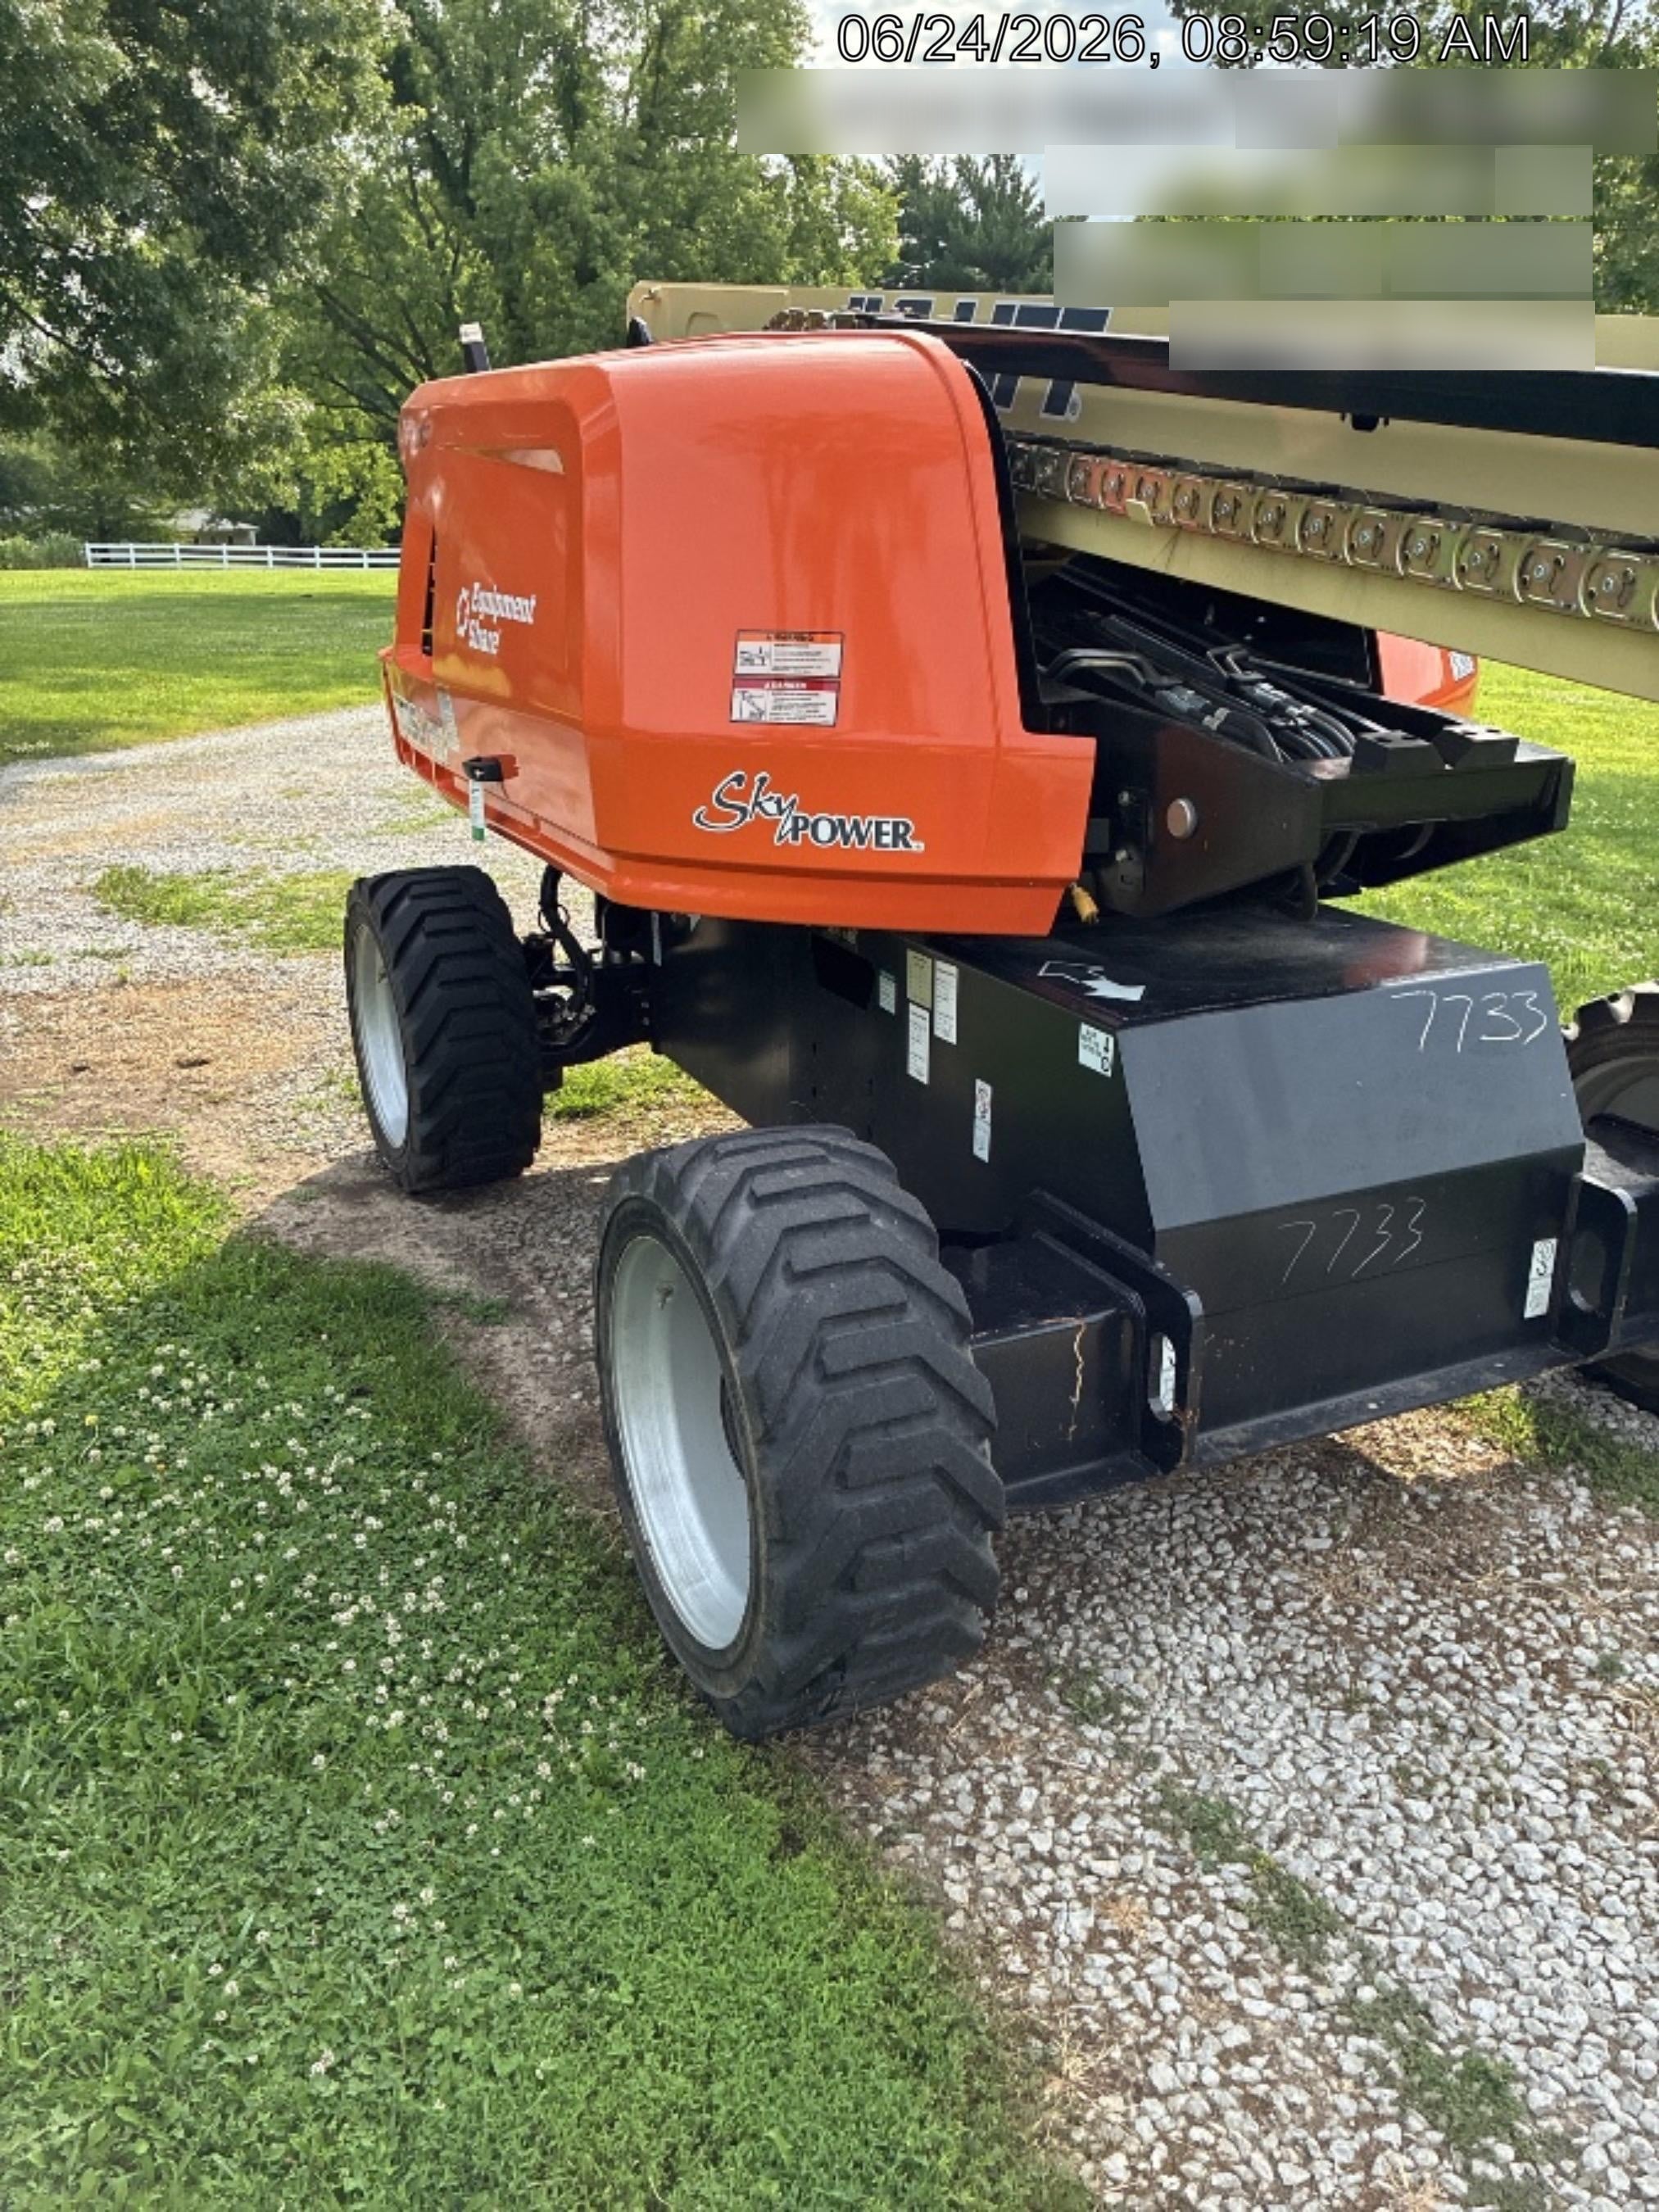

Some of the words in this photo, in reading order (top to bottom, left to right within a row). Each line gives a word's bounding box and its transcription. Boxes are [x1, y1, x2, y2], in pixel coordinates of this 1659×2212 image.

[471, 582, 537, 624] Equipment
[469, 619, 501, 655] Share
[1390, 989, 1548, 1054] 7733
[1277, 1195, 1427, 1285] 7733
